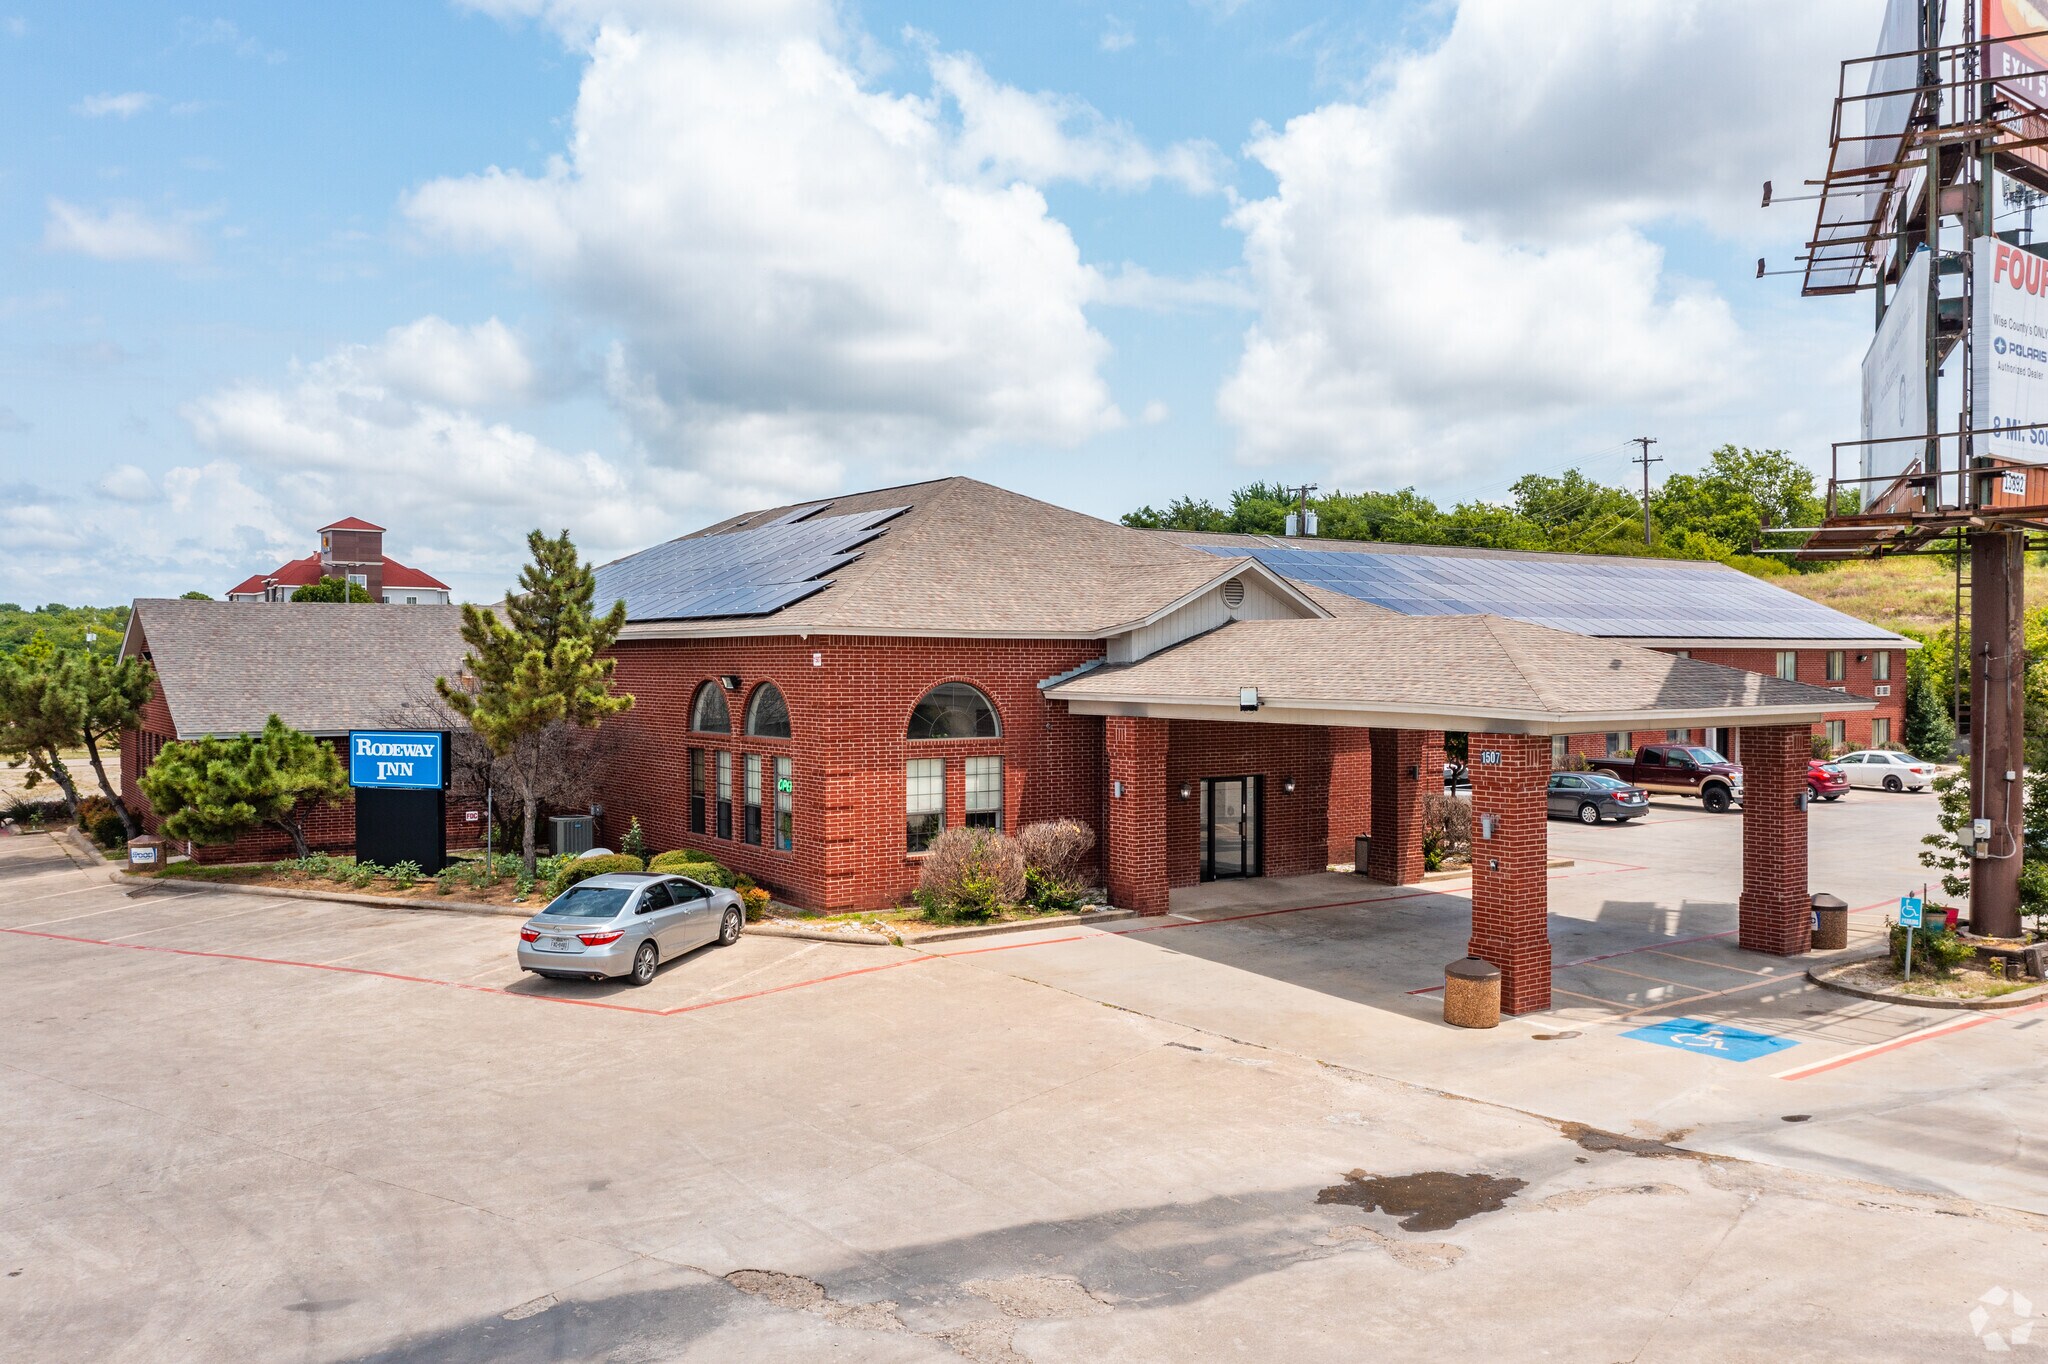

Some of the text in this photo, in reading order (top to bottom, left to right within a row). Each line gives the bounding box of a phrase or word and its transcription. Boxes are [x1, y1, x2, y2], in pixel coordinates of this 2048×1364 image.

[2003, 52, 2048, 98] EXIT S
[1993, 313, 2007, 328] Wise
[2009, 317, 2032, 336] County's
[2009, 342, 2047, 363] POLARIS
[1997, 361, 2044, 380] Authorized Dealer
[1993, 416, 2001, 438] 8
[2006, 418, 2025, 442] Mi.
[355, 739, 435, 757] RODEWAY
[1481, 751, 1500, 764] 1507
[376, 762, 414, 780] INN
